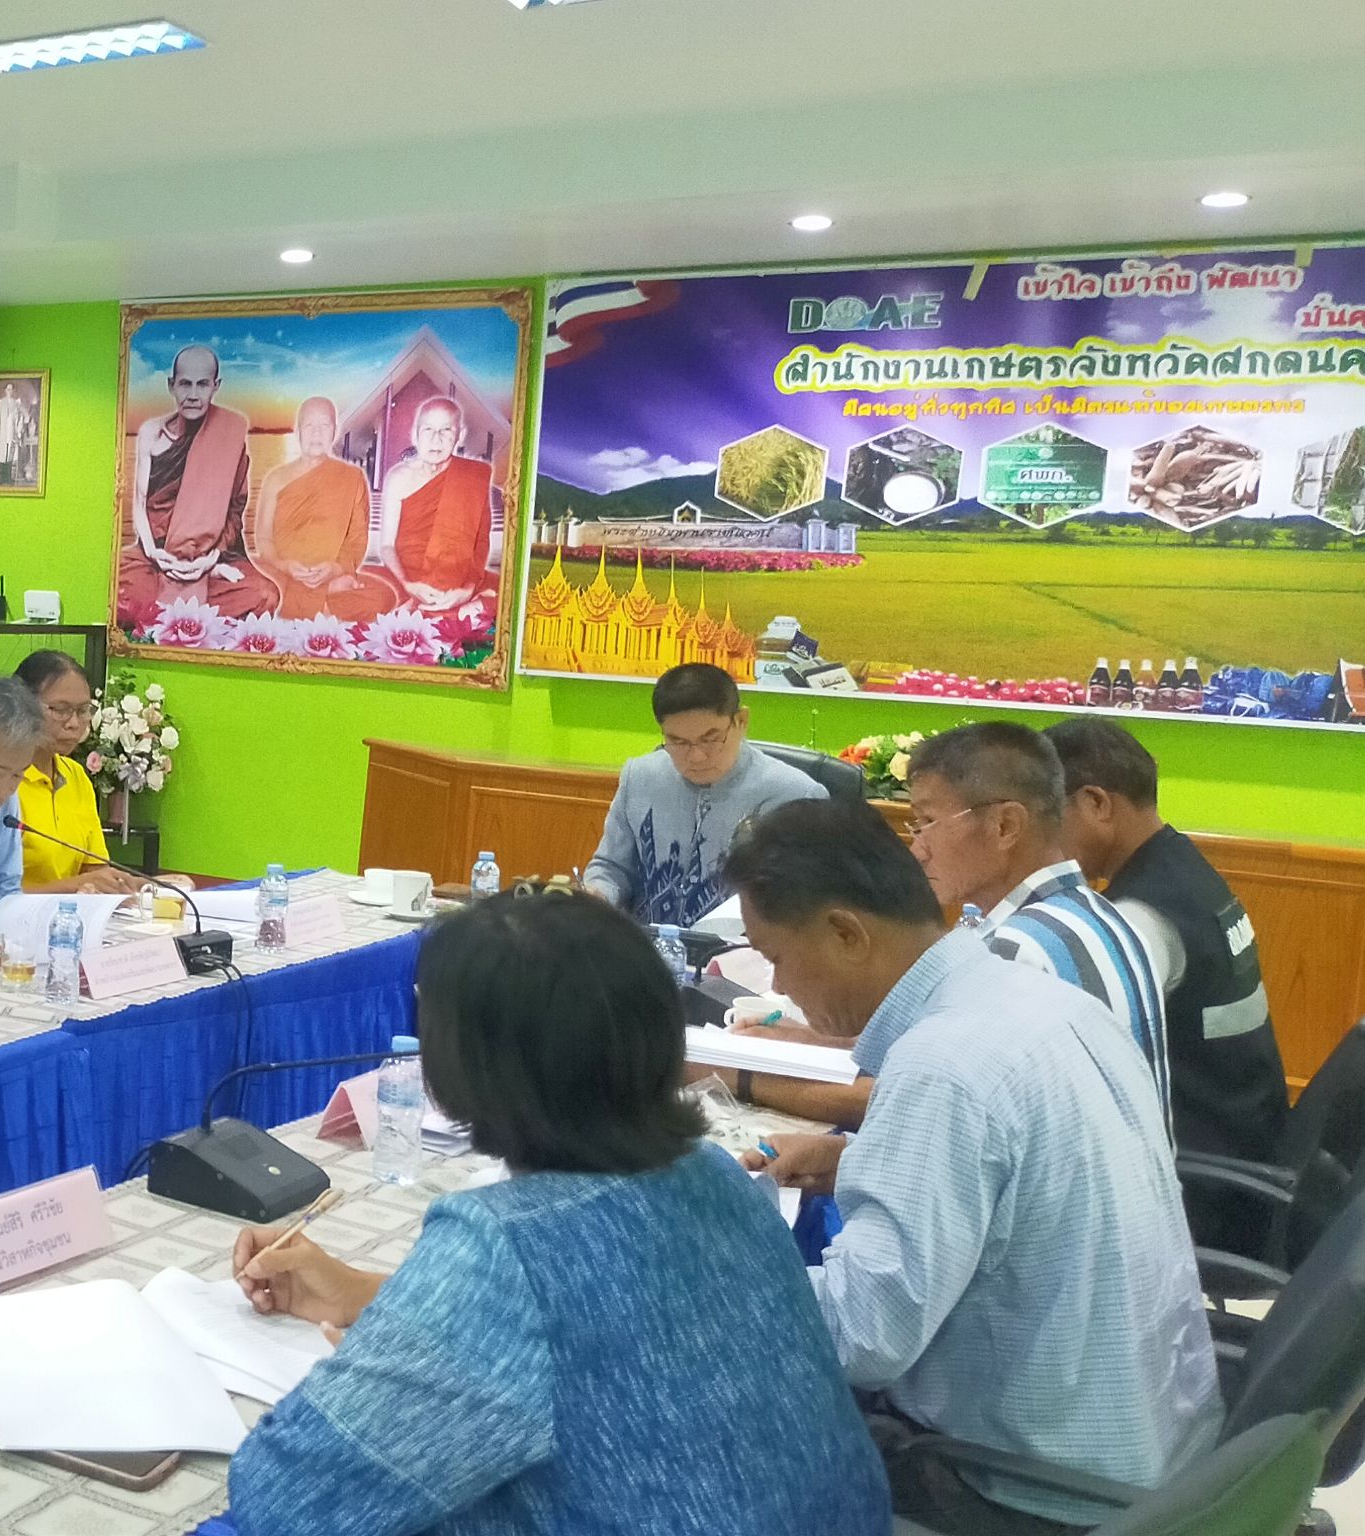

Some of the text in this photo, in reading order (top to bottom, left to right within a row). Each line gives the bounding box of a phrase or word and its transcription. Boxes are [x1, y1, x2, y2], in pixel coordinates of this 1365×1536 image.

[1022, 261, 1297, 296] เข้าใจ เข้าถึง พัฒนา
[30, 1198, 65, 1224] ศรีวิชัย
